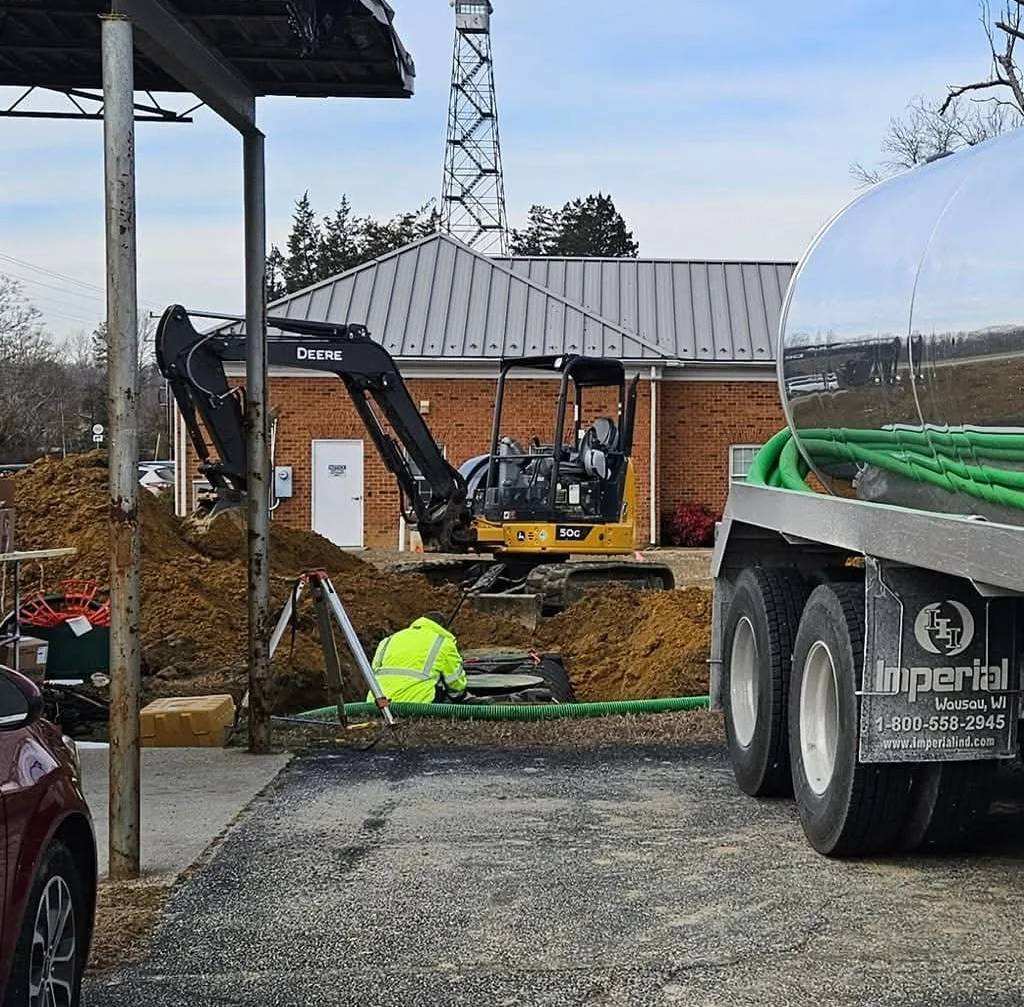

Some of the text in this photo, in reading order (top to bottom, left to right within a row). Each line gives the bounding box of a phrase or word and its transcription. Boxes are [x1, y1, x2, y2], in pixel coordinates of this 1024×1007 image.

[296, 347, 343, 361] DEERE
[559, 528, 581, 538] 50G
[875, 657, 1009, 703] Imperial
[935, 695, 1007, 712] Wausau, WI
[875, 714, 1006, 732] 1-800-558-2945
[882, 735, 996, 751] www.imperialind.com
